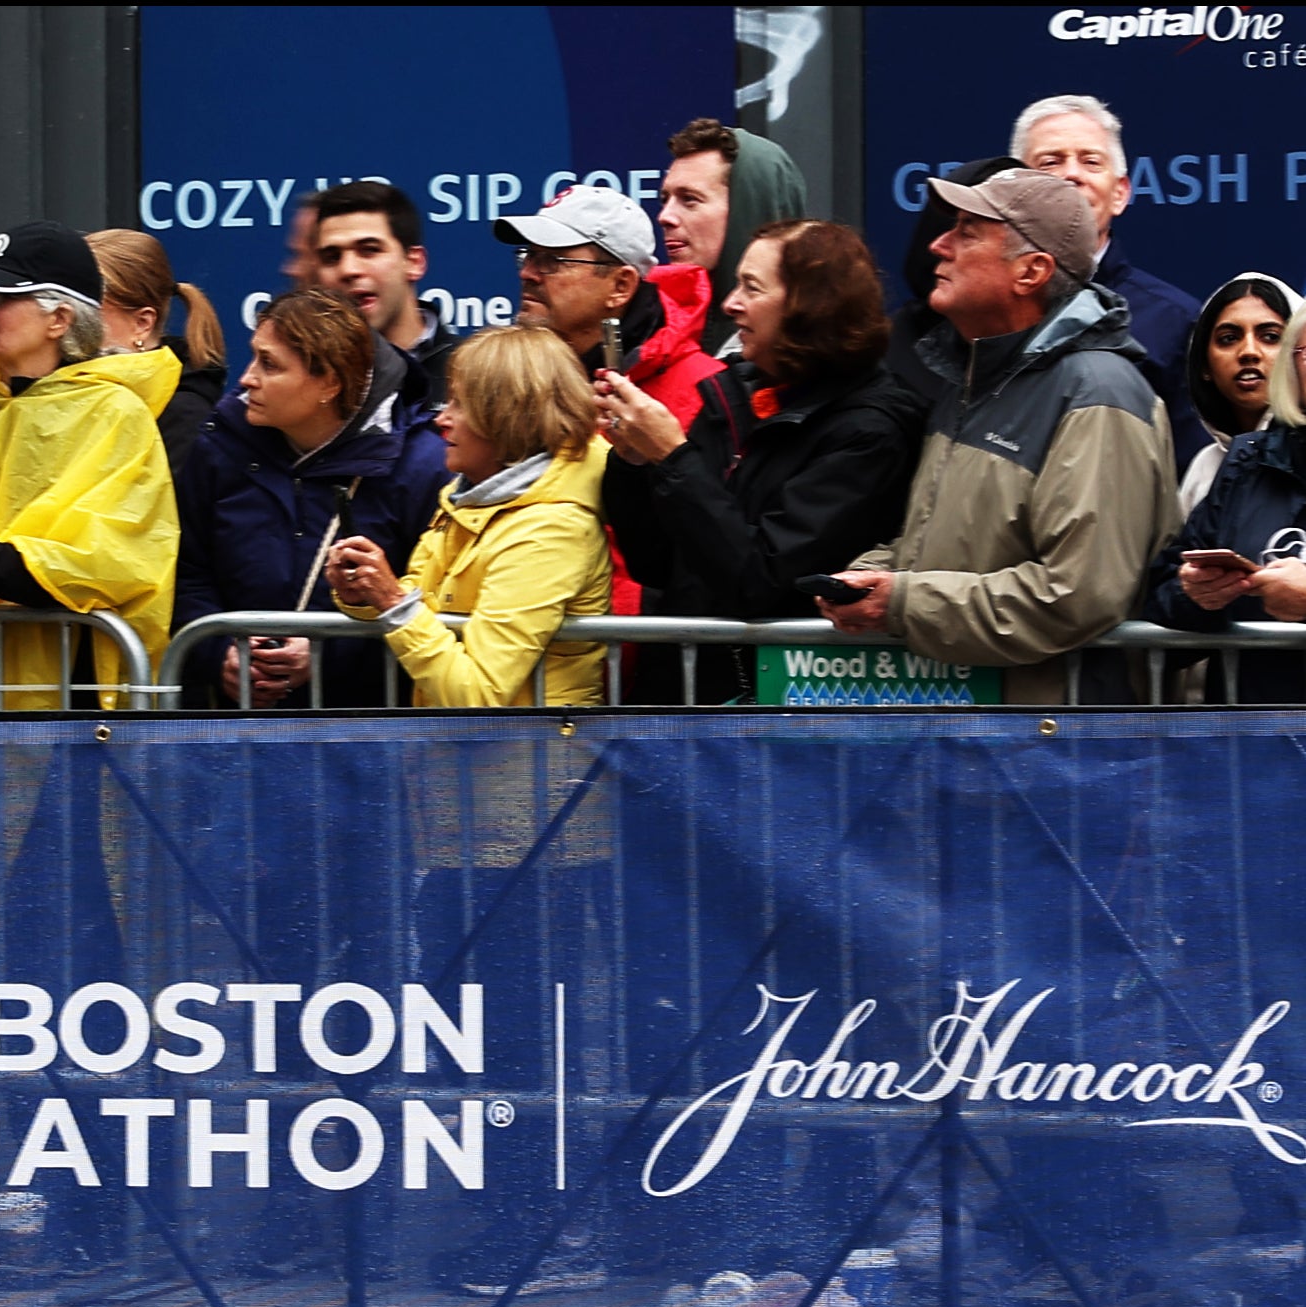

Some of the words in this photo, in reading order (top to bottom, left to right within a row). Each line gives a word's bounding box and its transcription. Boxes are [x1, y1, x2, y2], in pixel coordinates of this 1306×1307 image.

[1243, 43, 1306, 68] café
[140, 179, 296, 229] COZY
[428, 173, 522, 222] SIP
[1128, 153, 1249, 205] ASH
[785, 650, 867, 678] Wood
[875, 651, 898, 679] &
[641, 984, 899, 1197] John
